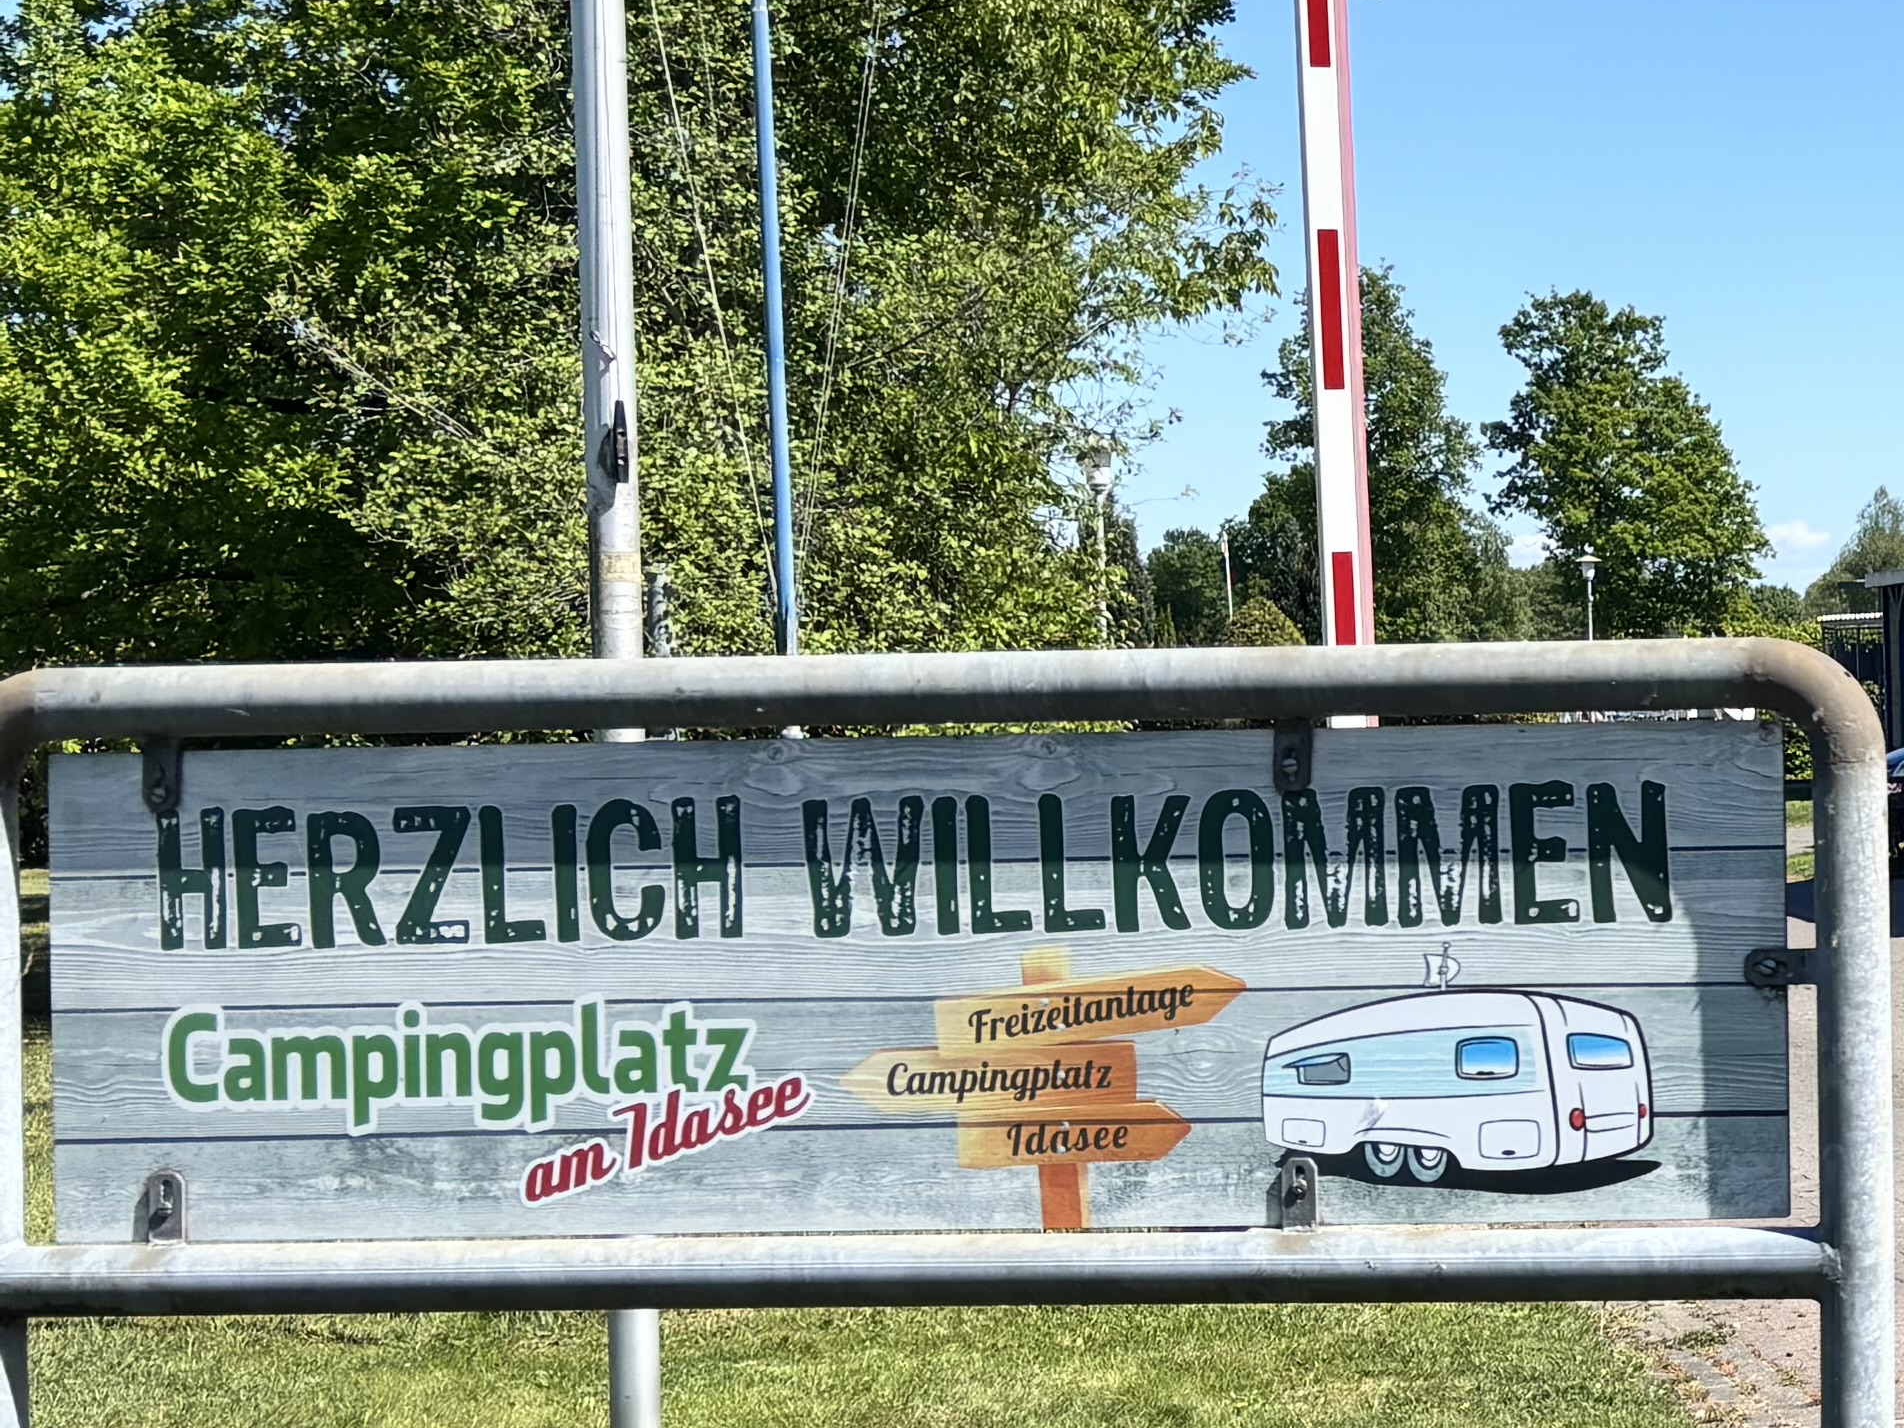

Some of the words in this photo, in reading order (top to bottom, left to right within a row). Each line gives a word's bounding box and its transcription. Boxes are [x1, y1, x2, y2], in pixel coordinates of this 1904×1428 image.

[156, 794, 743, 950] HERZLICH
[801, 782, 1673, 938] WILLKOMMEN
[968, 983, 1194, 1043] Freizeitanlage
[168, 1001, 750, 1129] Campingplatz
[887, 1059, 1112, 1104] Campingplatz
[525, 1139, 616, 1203] am
[612, 1076, 810, 1170] Idasee
[1007, 1123, 1128, 1156] Idasee
